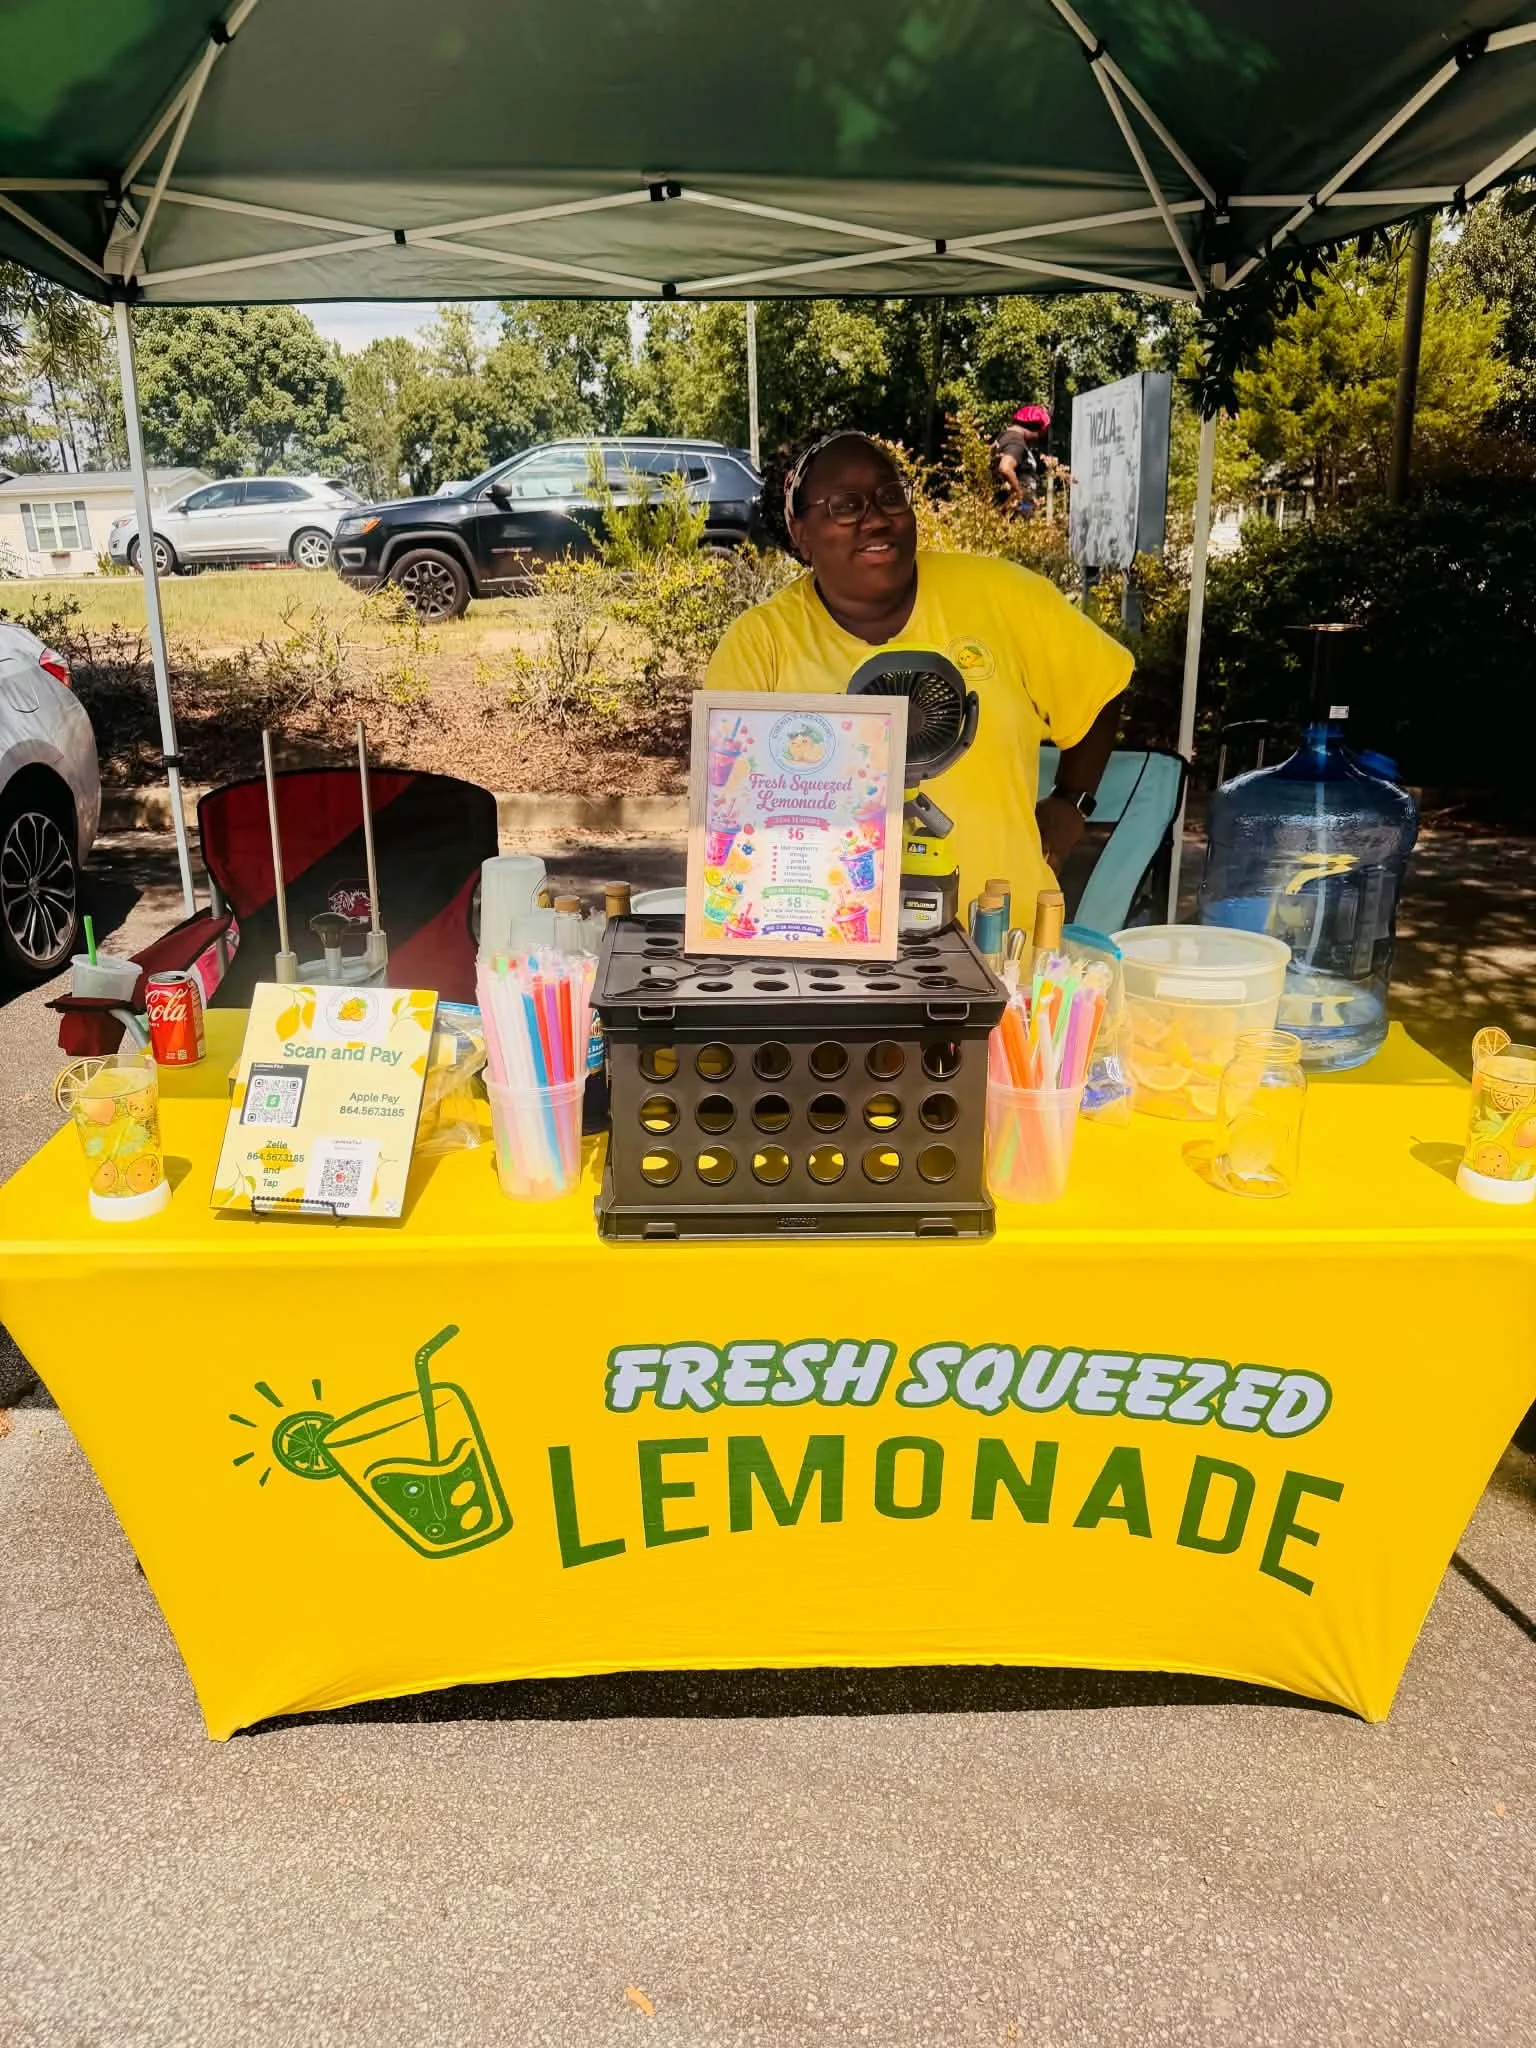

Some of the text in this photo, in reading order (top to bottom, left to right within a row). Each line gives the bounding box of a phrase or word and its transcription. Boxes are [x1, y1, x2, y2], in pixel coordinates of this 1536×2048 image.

[749, 773, 853, 795] Fresh Squeezed
[756, 790, 837, 812] Lemonade
[283, 1042, 403, 1066] Scan and Pay
[349, 1091, 400, 1105] Apple Pay
[265, 1140, 288, 1149] Zelle
[605, 1339, 1333, 1438] FRESH SQUEEZED
[548, 1434, 1345, 1597] LEMONADE
